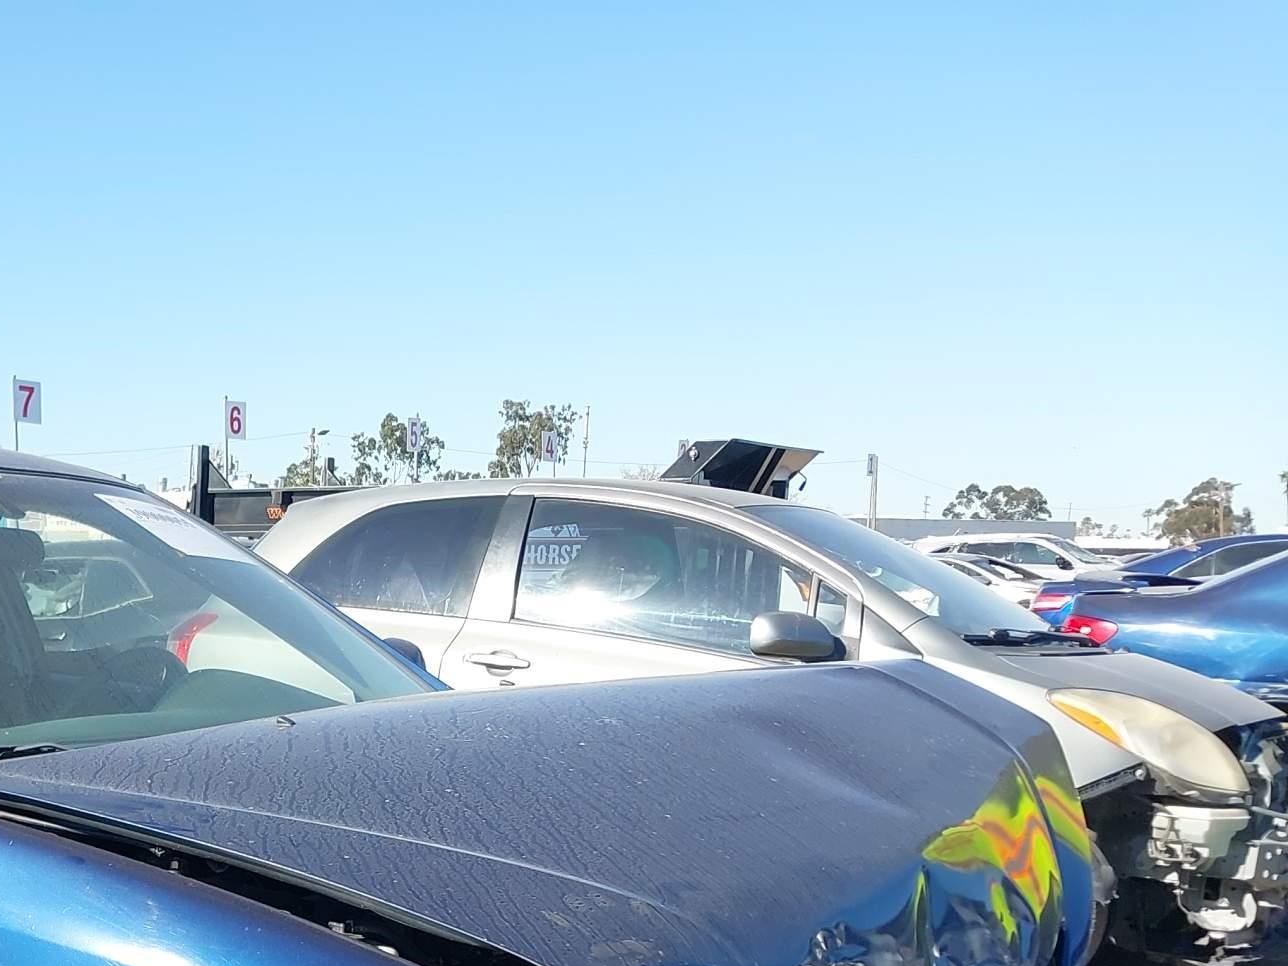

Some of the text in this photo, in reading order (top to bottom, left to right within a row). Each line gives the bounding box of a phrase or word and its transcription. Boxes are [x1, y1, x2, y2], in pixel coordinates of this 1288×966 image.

[18, 385, 36, 418] 7
[229, 406, 242, 435] 6
[410, 421, 418, 448] 5
[545, 435, 555, 457] 4
